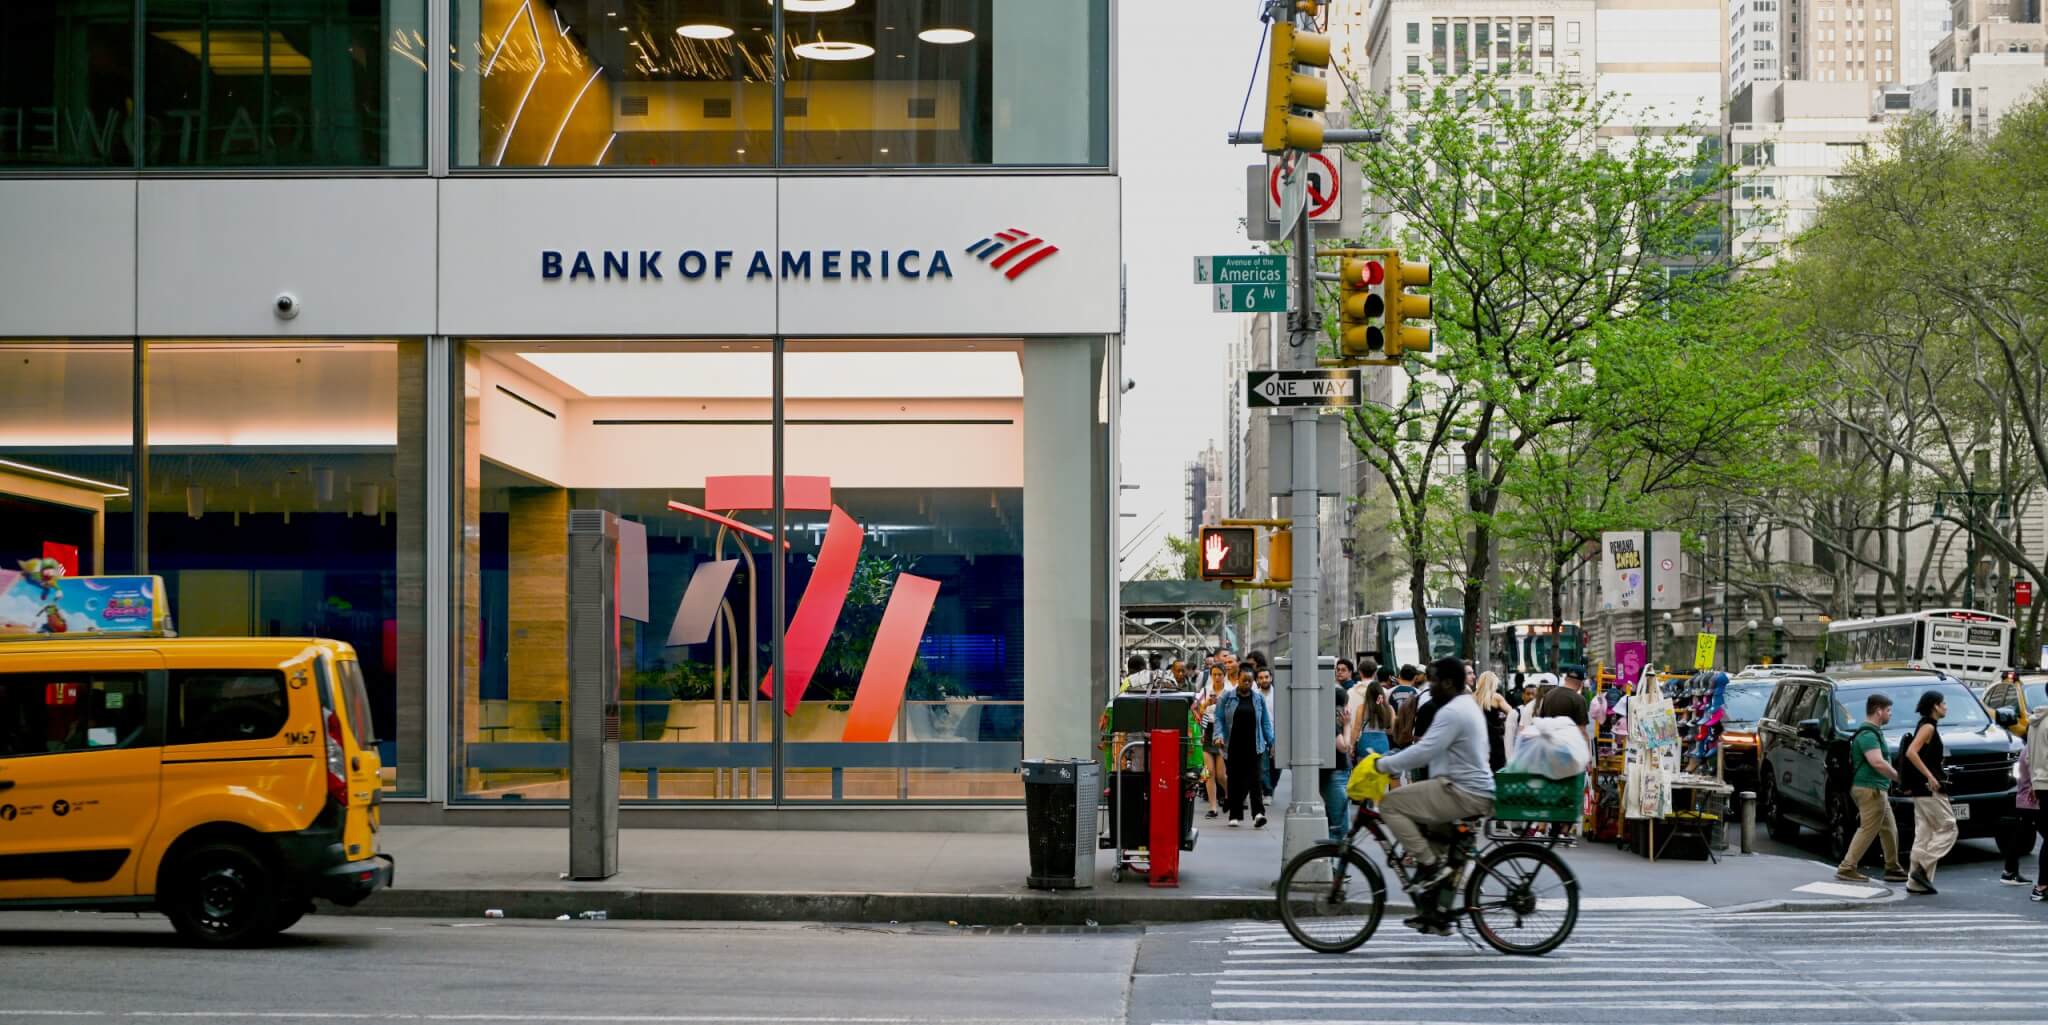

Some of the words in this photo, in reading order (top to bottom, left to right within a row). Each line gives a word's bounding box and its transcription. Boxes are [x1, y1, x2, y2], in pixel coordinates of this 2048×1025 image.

[541, 250, 664, 280] BANK
[677, 249, 734, 281] OF
[746, 249, 954, 280] AMERICA
[1226, 258, 1251, 266] Avenue
[1253, 258, 1261, 266] of
[1262, 258, 1274, 266] the
[1220, 266, 1281, 281] Americas
[1245, 288, 1256, 309] 6
[1263, 286, 1276, 299] Av
[1265, 381, 1297, 396] ONE
[1312, 380, 1347, 396] WAY
